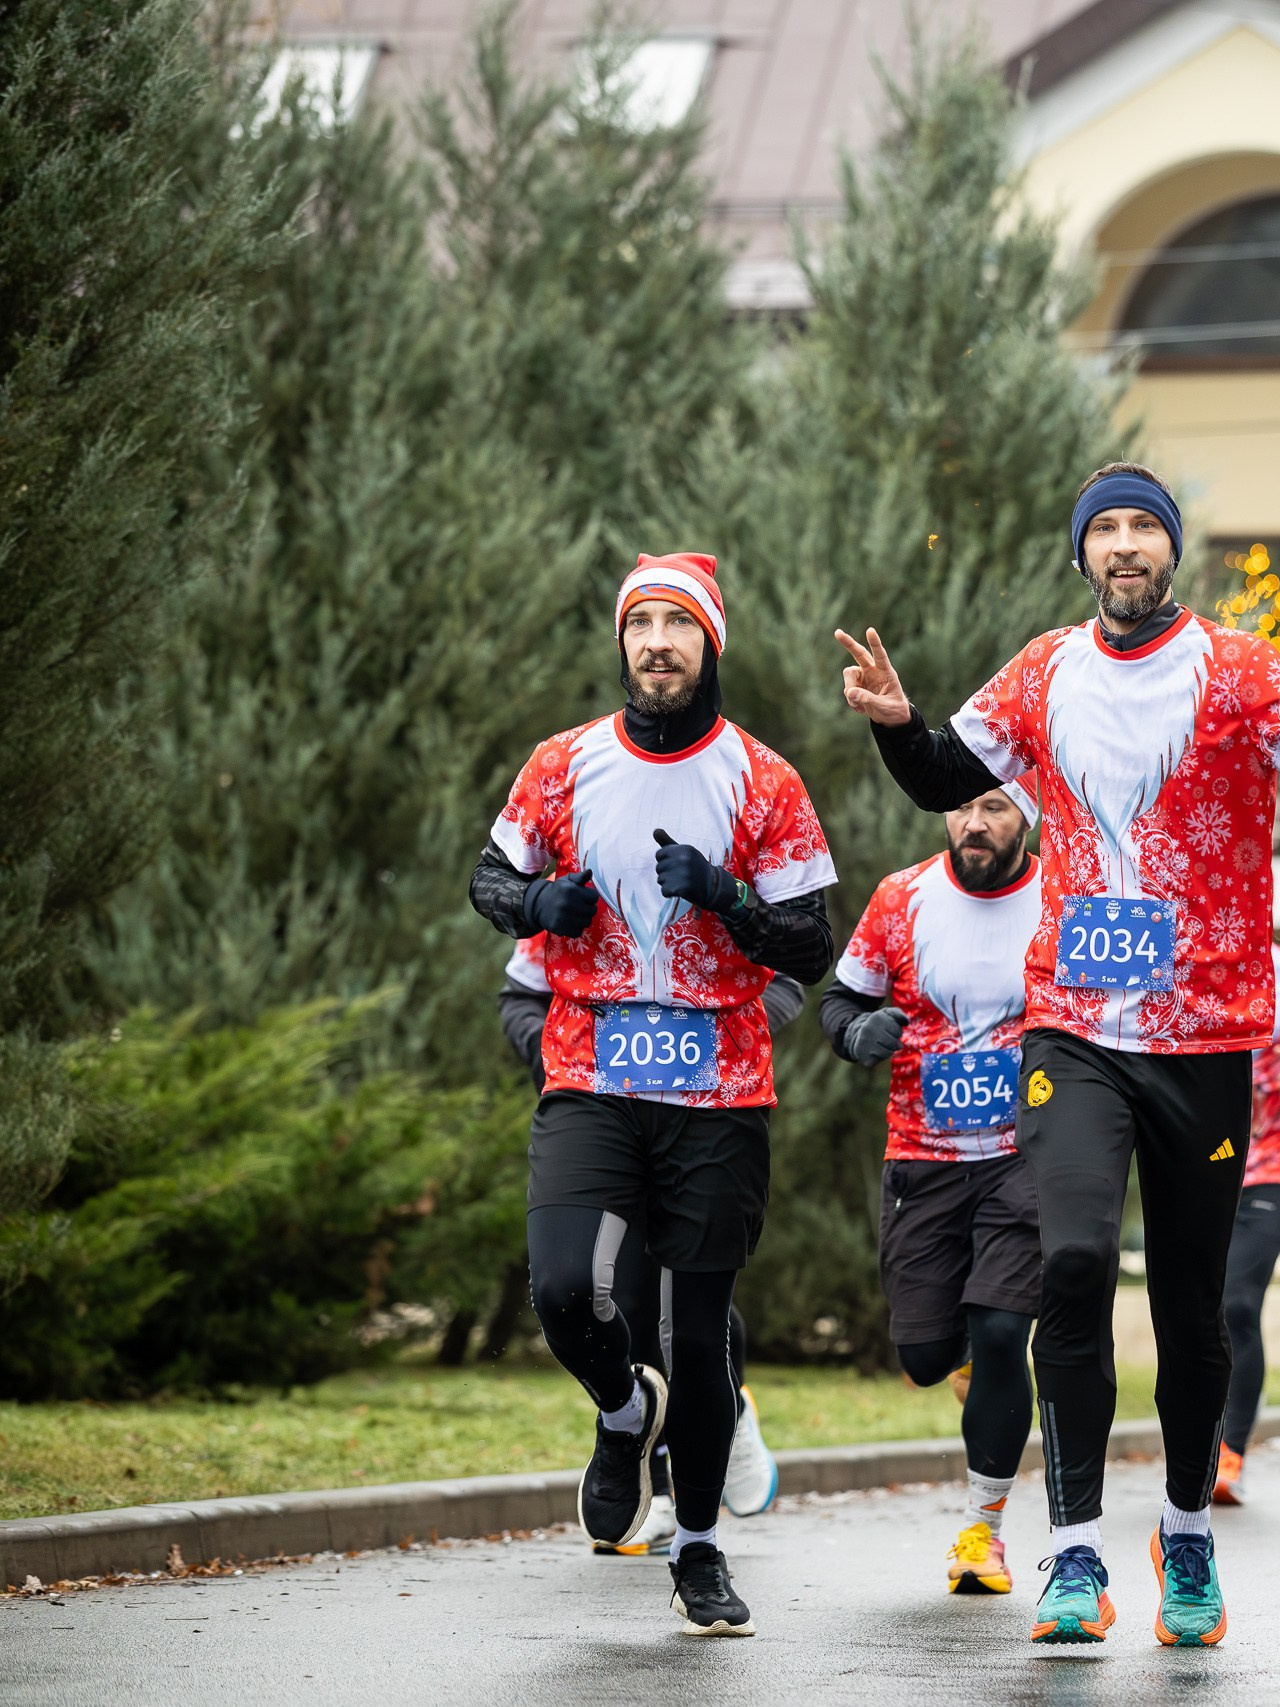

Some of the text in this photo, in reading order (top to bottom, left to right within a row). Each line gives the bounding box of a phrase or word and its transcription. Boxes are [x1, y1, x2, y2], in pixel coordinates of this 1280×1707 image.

[1069, 925, 1159, 964] 2034
[1101, 975, 1107, 983] 5
[608, 1031, 701, 1067] 2036
[931, 1074, 1013, 1108] 2054
